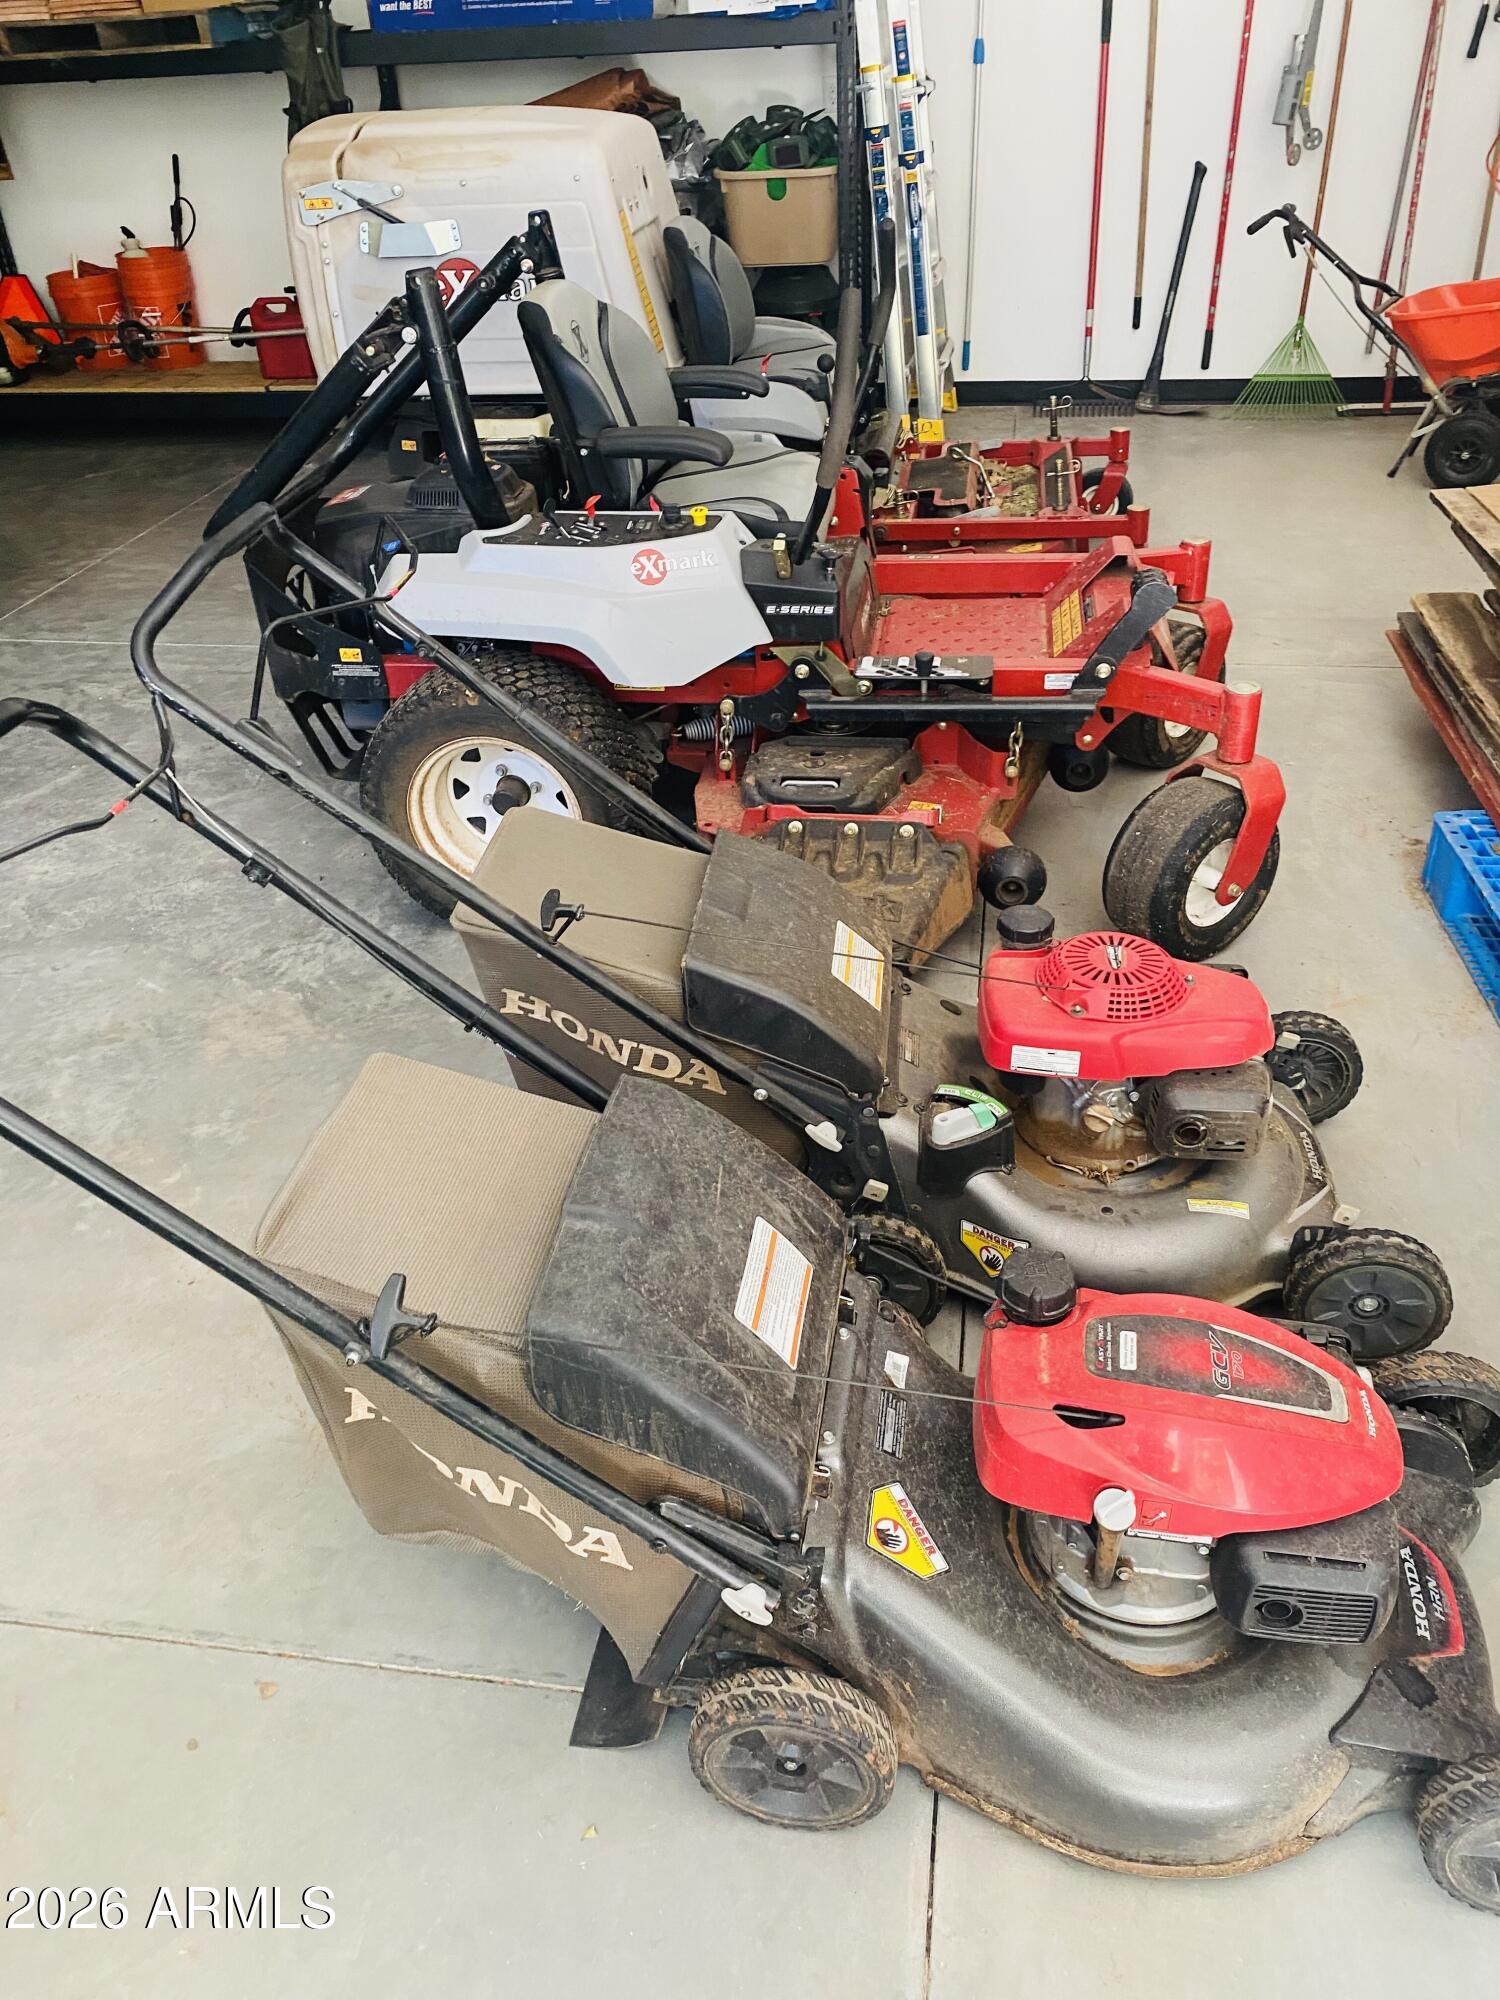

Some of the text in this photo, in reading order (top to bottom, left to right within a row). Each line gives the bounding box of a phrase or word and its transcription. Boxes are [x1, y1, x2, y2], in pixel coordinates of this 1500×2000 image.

[379, 0, 432, 12] want the BEST
[766, 605, 834, 614] E-SERIES
[500, 988, 727, 1095] HONDA
[1299, 1130, 1323, 1181] HONDA
[972, 1226, 1015, 1249] DANGER
[1208, 1330, 1231, 1391] GCV
[1231, 1350, 1244, 1380] 170
[1361, 1389, 1376, 1439] HONDA
[897, 1498, 936, 1556] DANGER
[1400, 1545, 1431, 1641] HONDA
[1425, 1575, 1446, 1621] HRN
